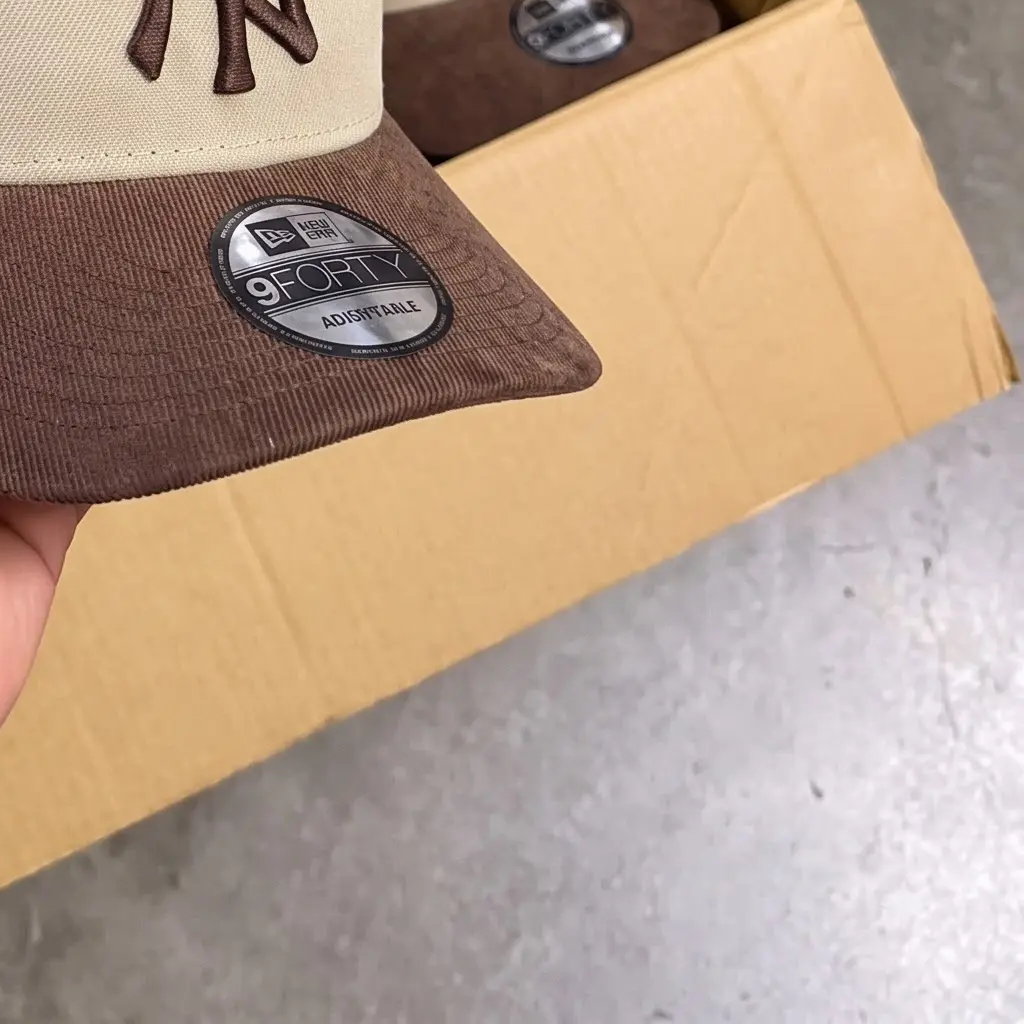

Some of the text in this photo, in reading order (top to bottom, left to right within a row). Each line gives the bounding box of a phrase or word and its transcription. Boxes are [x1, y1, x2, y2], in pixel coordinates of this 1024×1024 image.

[296, 218, 331, 232] NEW
[305, 228, 339, 240] ERA
[245, 253, 408, 306] 9FORTY
